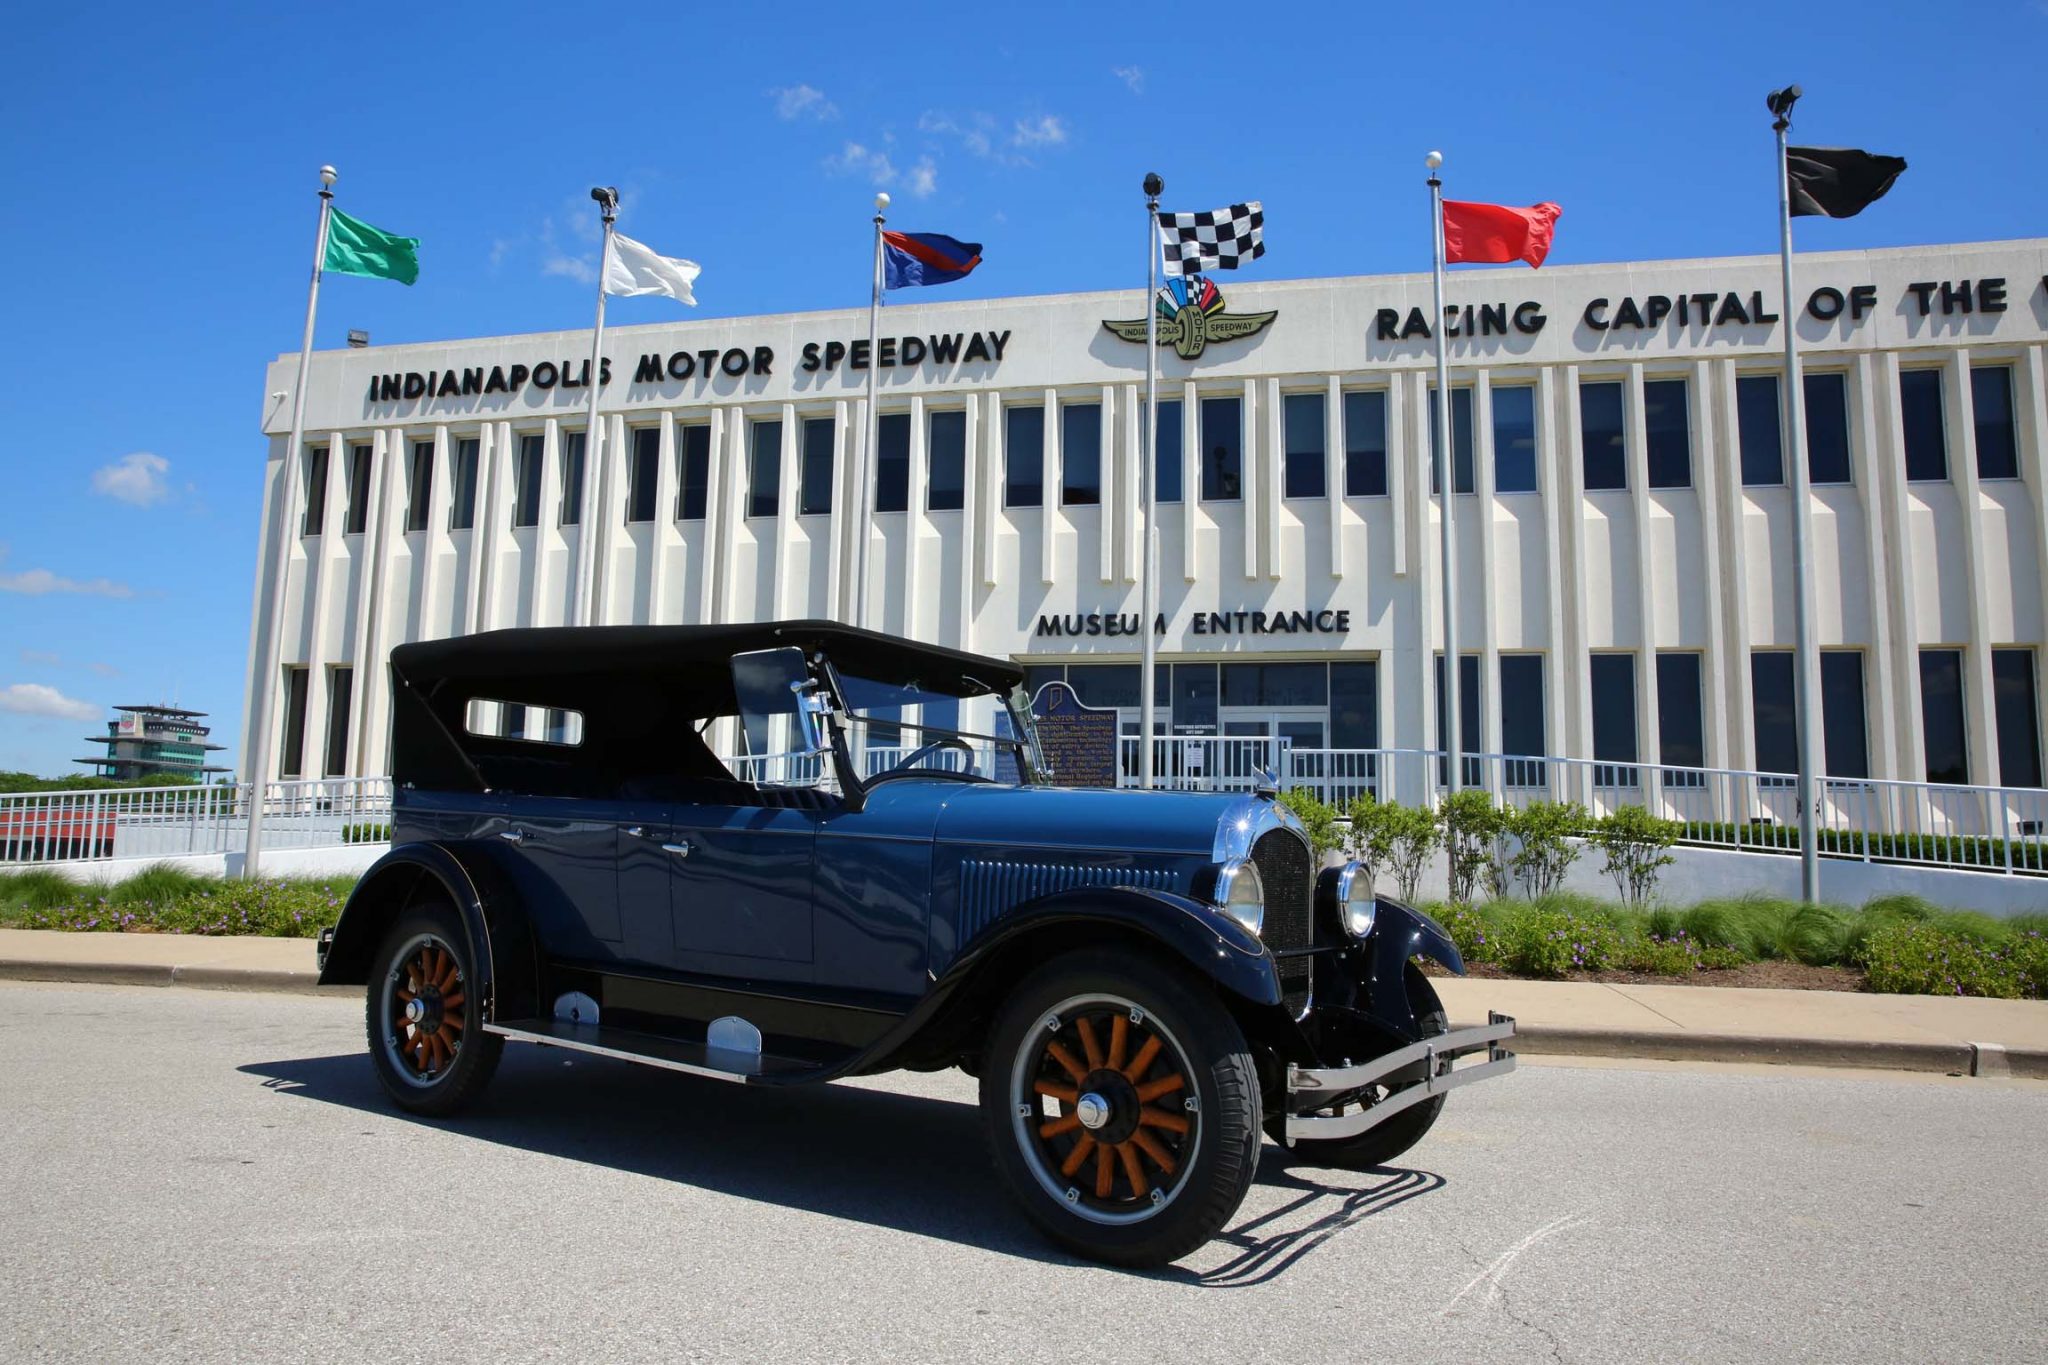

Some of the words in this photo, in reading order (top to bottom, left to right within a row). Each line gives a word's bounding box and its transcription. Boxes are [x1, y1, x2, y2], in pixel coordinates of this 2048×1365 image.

[1377, 301, 1547, 340] RACING
[1584, 291, 1779, 330] CAPITAL
[1807, 285, 1877, 320] OF
[1908, 278, 2007, 316] THE
[1125, 326, 1179, 336] INDIAPOLIS
[1192, 311, 1203, 350] MOTOR
[1211, 322, 1252, 332] SPEEDWAY
[370, 357, 612, 401] INDIANAPOLIS
[635, 346, 774, 383] MOTOR
[802, 330, 1011, 372] SPEEDWAY
[1193, 610, 1350, 634] ENTRANCE
